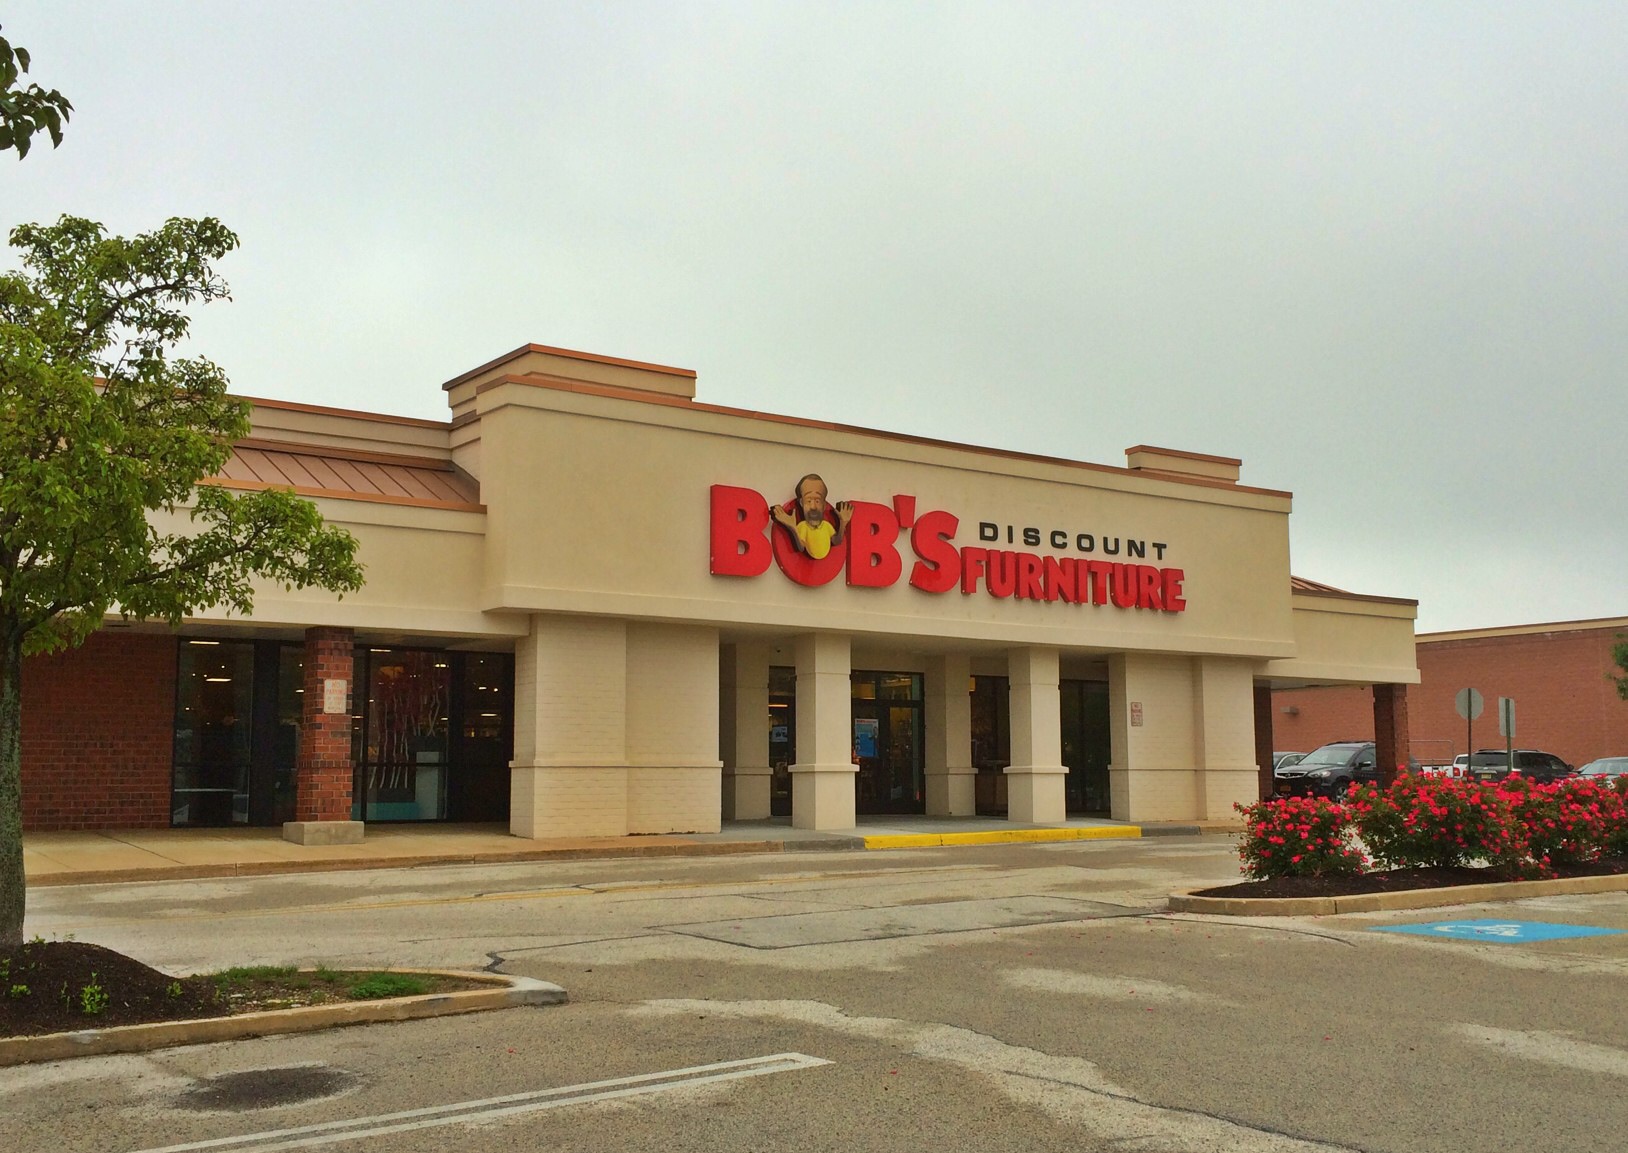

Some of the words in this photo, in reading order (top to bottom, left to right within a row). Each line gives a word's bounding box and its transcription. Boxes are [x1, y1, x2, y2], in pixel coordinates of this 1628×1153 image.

[710, 484, 962, 593] BOB'S
[979, 521, 1168, 561] DISCOUNT
[960, 546, 1187, 612] FURNITURE
